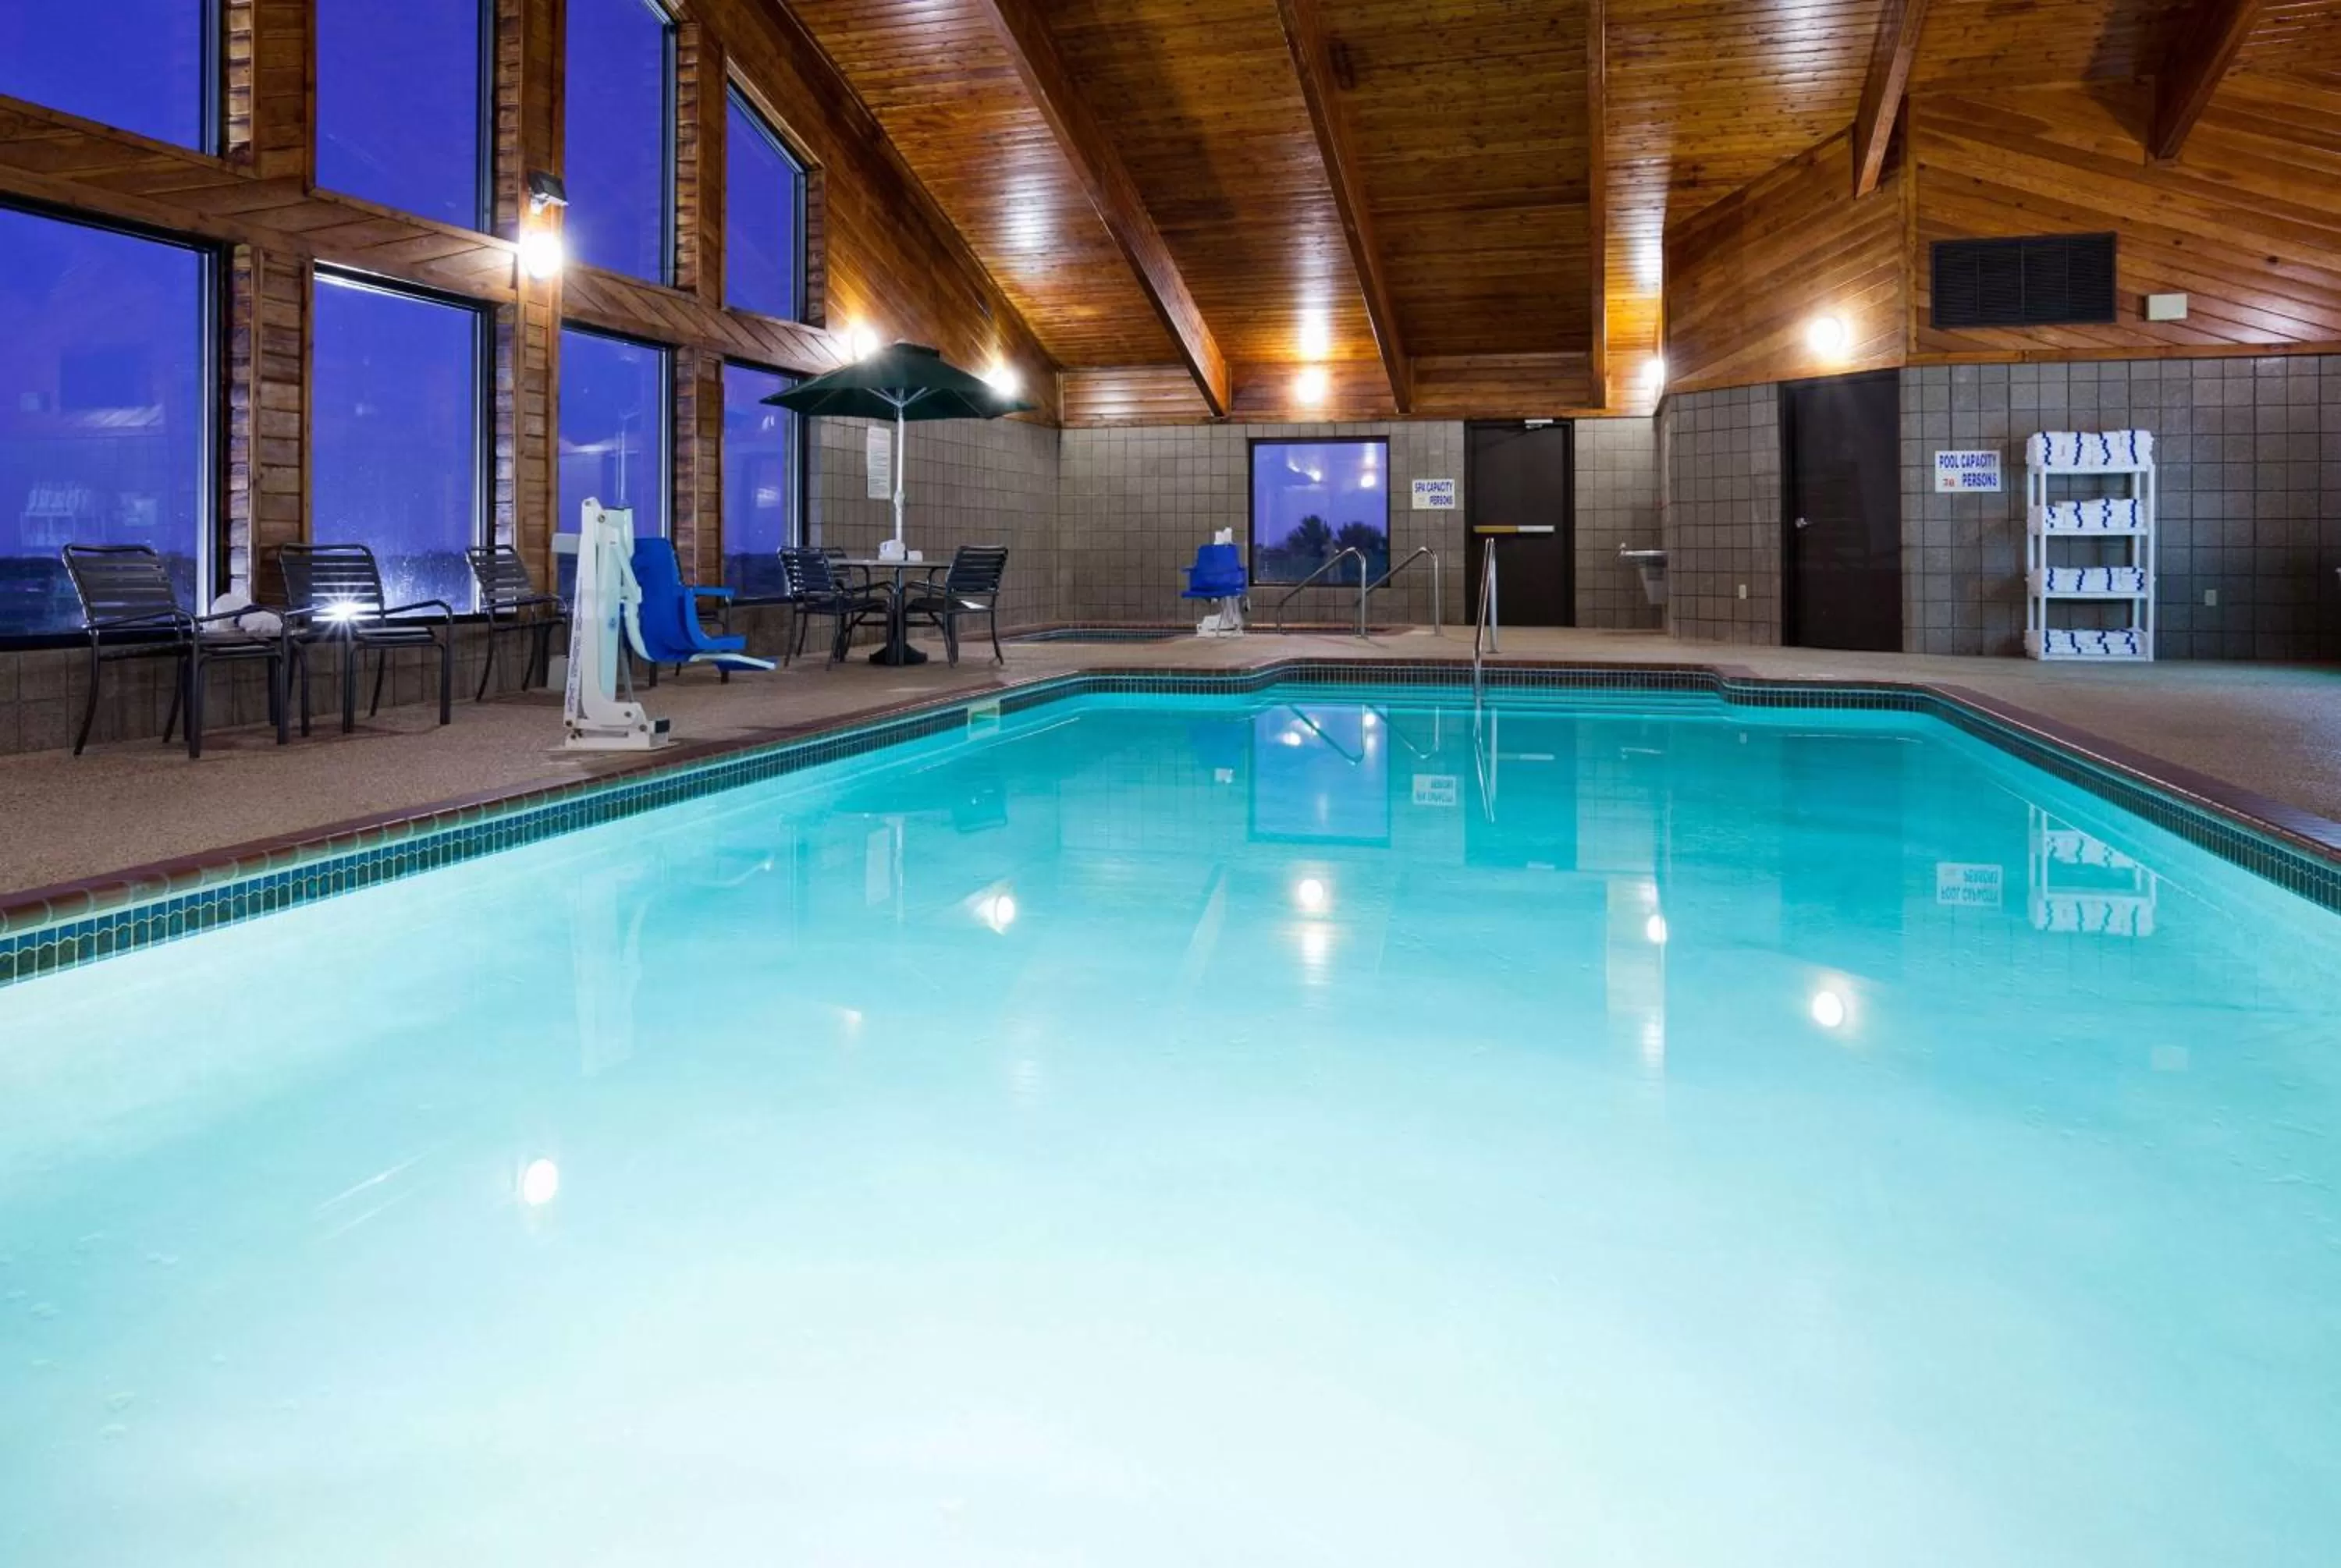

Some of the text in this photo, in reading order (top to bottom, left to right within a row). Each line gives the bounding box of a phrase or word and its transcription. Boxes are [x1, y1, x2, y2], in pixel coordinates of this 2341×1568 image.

[1939, 454, 1996, 468] POOL CAPACITY
[1963, 473, 1997, 487] PERSONS
[1415, 481, 1452, 493] SPA CAPACITY
[1430, 495, 1453, 506] PERSONS
